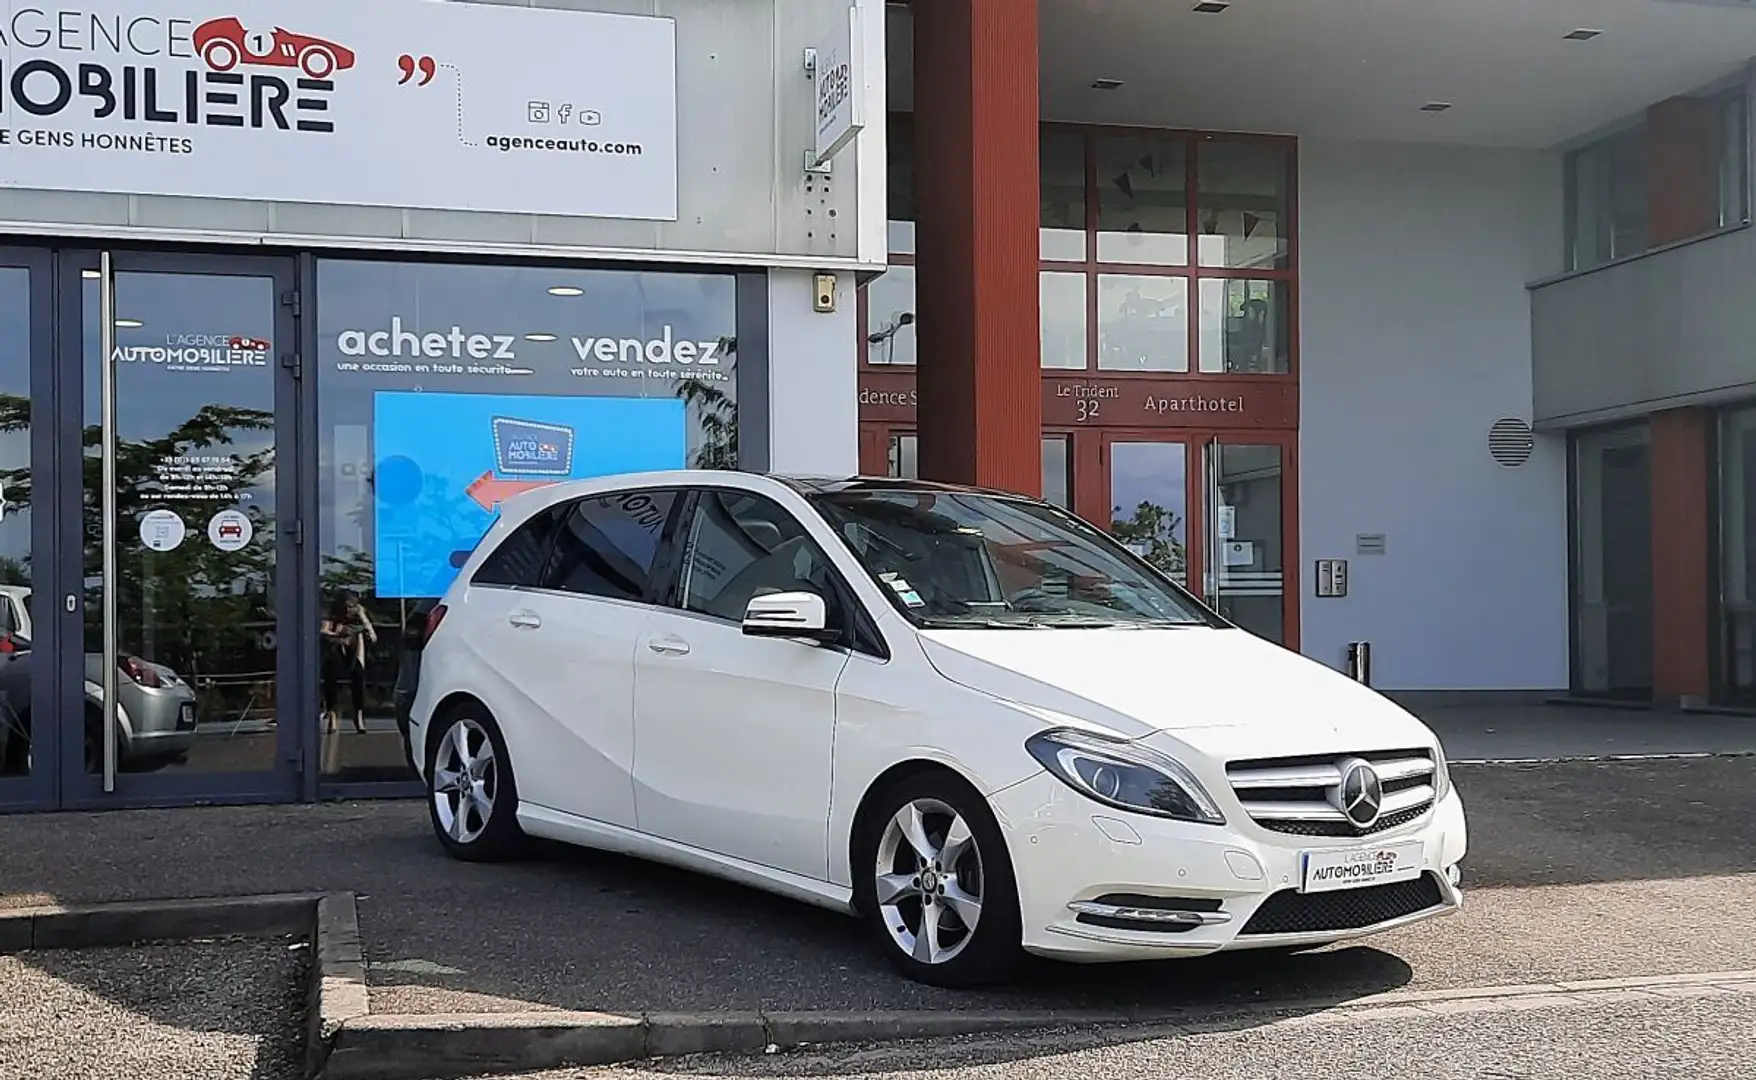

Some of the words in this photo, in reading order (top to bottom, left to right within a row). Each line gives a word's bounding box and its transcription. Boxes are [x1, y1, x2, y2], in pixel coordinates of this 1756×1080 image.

[0, 59, 334, 132] OBILIERE
[17, 130, 74, 147] GENS
[81, 132, 193, 154] HONNÊTES
[486, 135, 643, 155] agenceauto.com
[166, 334, 230, 347] L'AGENCE
[337, 316, 516, 360] achetez
[571, 325, 720, 365] vendez
[111, 346, 266, 365] AUTOMOBILIERE
[337, 362, 360, 371] une
[362, 361, 412, 373] occasion
[415, 363, 429, 373] en
[433, 363, 464, 374] toute
[570, 368, 600, 377] votre
[602, 368, 628, 378] auto
[631, 370, 645, 379] en
[648, 368, 677, 380] toute
[859, 387, 907, 406] dence
[1056, 384, 1071, 397] Le
[1074, 384, 1120, 398] Trident
[1076, 400, 1100, 422] 32
[1144, 396, 1244, 414] Aparthotel
[509, 440, 538, 451] AUTO
